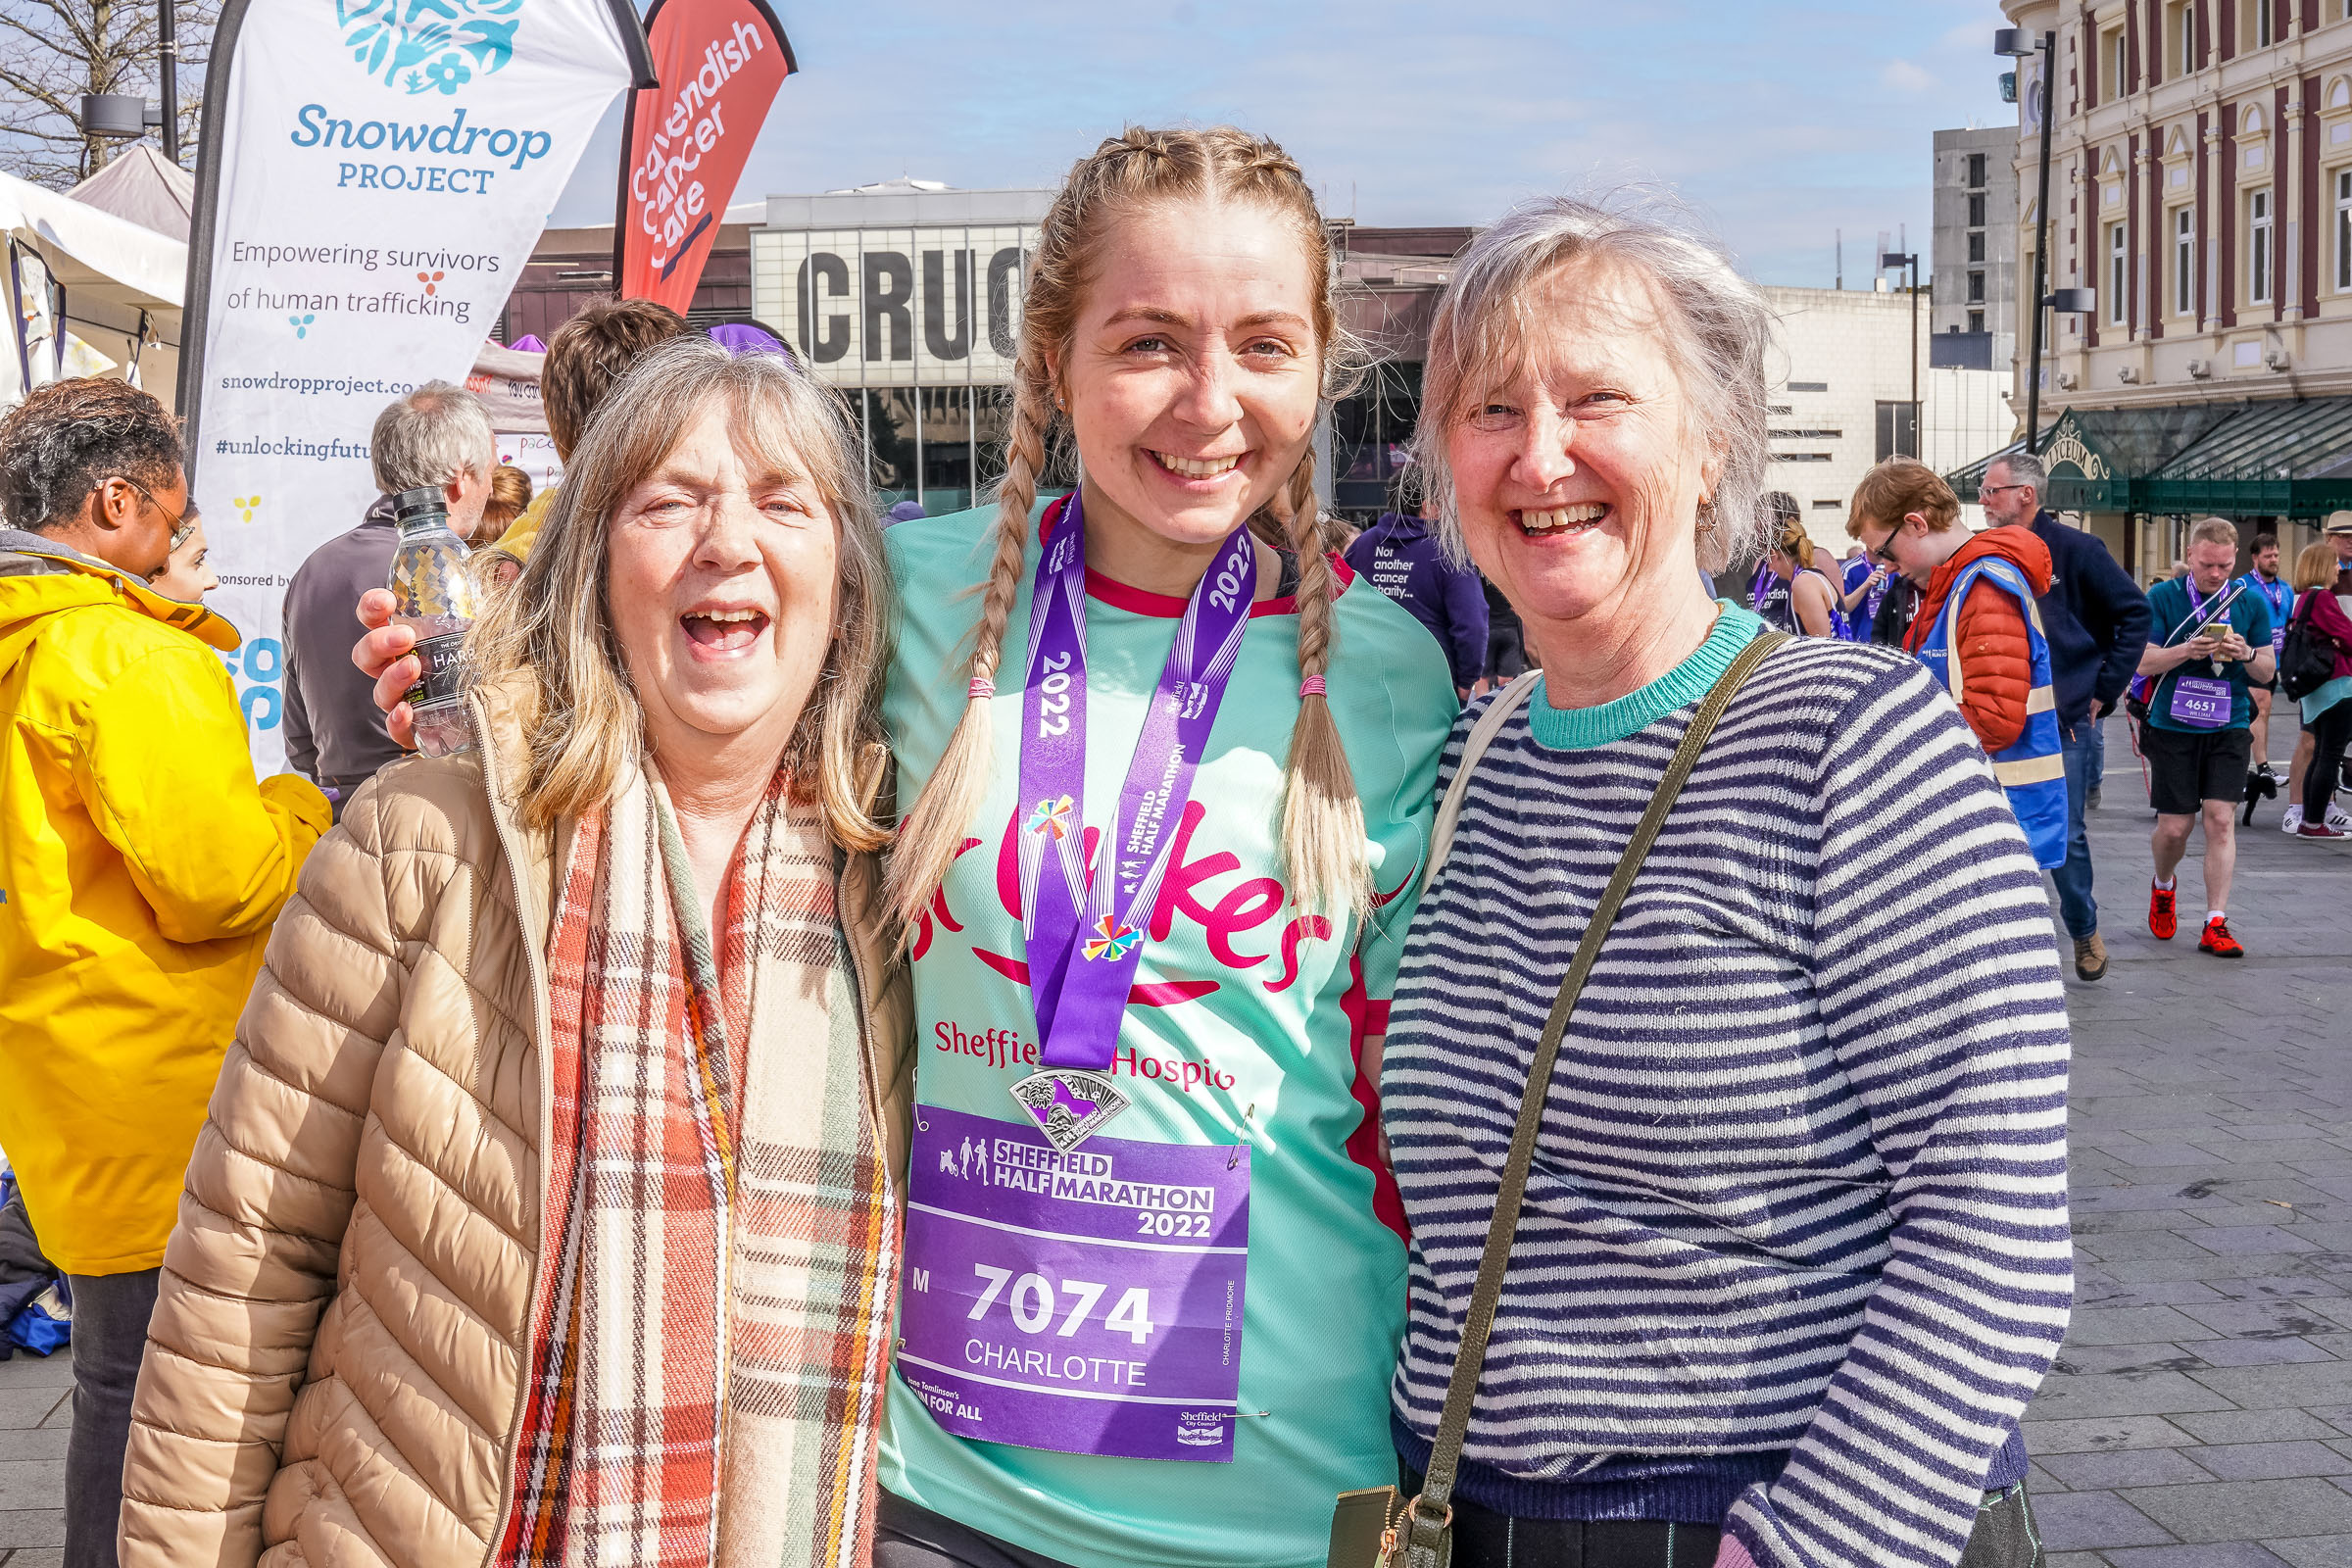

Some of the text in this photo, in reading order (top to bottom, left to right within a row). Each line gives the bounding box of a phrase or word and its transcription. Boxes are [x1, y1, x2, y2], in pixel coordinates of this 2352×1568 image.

[633, 21, 763, 202] cavendish
[290, 103, 552, 170] Snowdrop
[337, 163, 494, 194] PROJECT
[643, 101, 725, 235] cancer
[651, 180, 705, 270] care
[233, 241, 500, 272] Empowering survivors
[227, 288, 470, 324] of human trafficking
[798, 247, 1027, 363] CRUC
[221, 371, 424, 395] snowdropproject.co
[216, 436, 371, 461] #unlockingfutu
[2049, 440, 2087, 469] LYCEUM
[217, 574, 273, 586] onsored
[1209, 534, 1251, 614] 2022
[1373, 573, 1408, 584] cancer
[1374, 559, 1414, 571] another
[1746, 588, 1788, 601] candish
[1040, 651, 1071, 738] 2022
[2185, 699, 2216, 711] 4651
[1140, 744, 1186, 856] HALF MARATHON
[1127, 790, 1156, 854] SHEFFIELD
[935, 1021, 1037, 1068] Sheffie
[996, 1141, 1108, 1176] SHEFFIELD
[994, 1165, 1211, 1209] HALF MARATHON
[1138, 1211, 1211, 1237] 2022
[912, 1267, 929, 1294] M
[966, 1263, 1153, 1345] 7074
[1223, 1280, 1235, 1366] CHARLOTTE PRIDMORE
[964, 1339, 1148, 1387] CHARLOTTE
[921, 1381, 959, 1399] Tomlinson's
[930, 1396, 953, 1415] FOR
[956, 1404, 983, 1421] ALL
[1181, 1411, 1221, 1421] Sheffield
